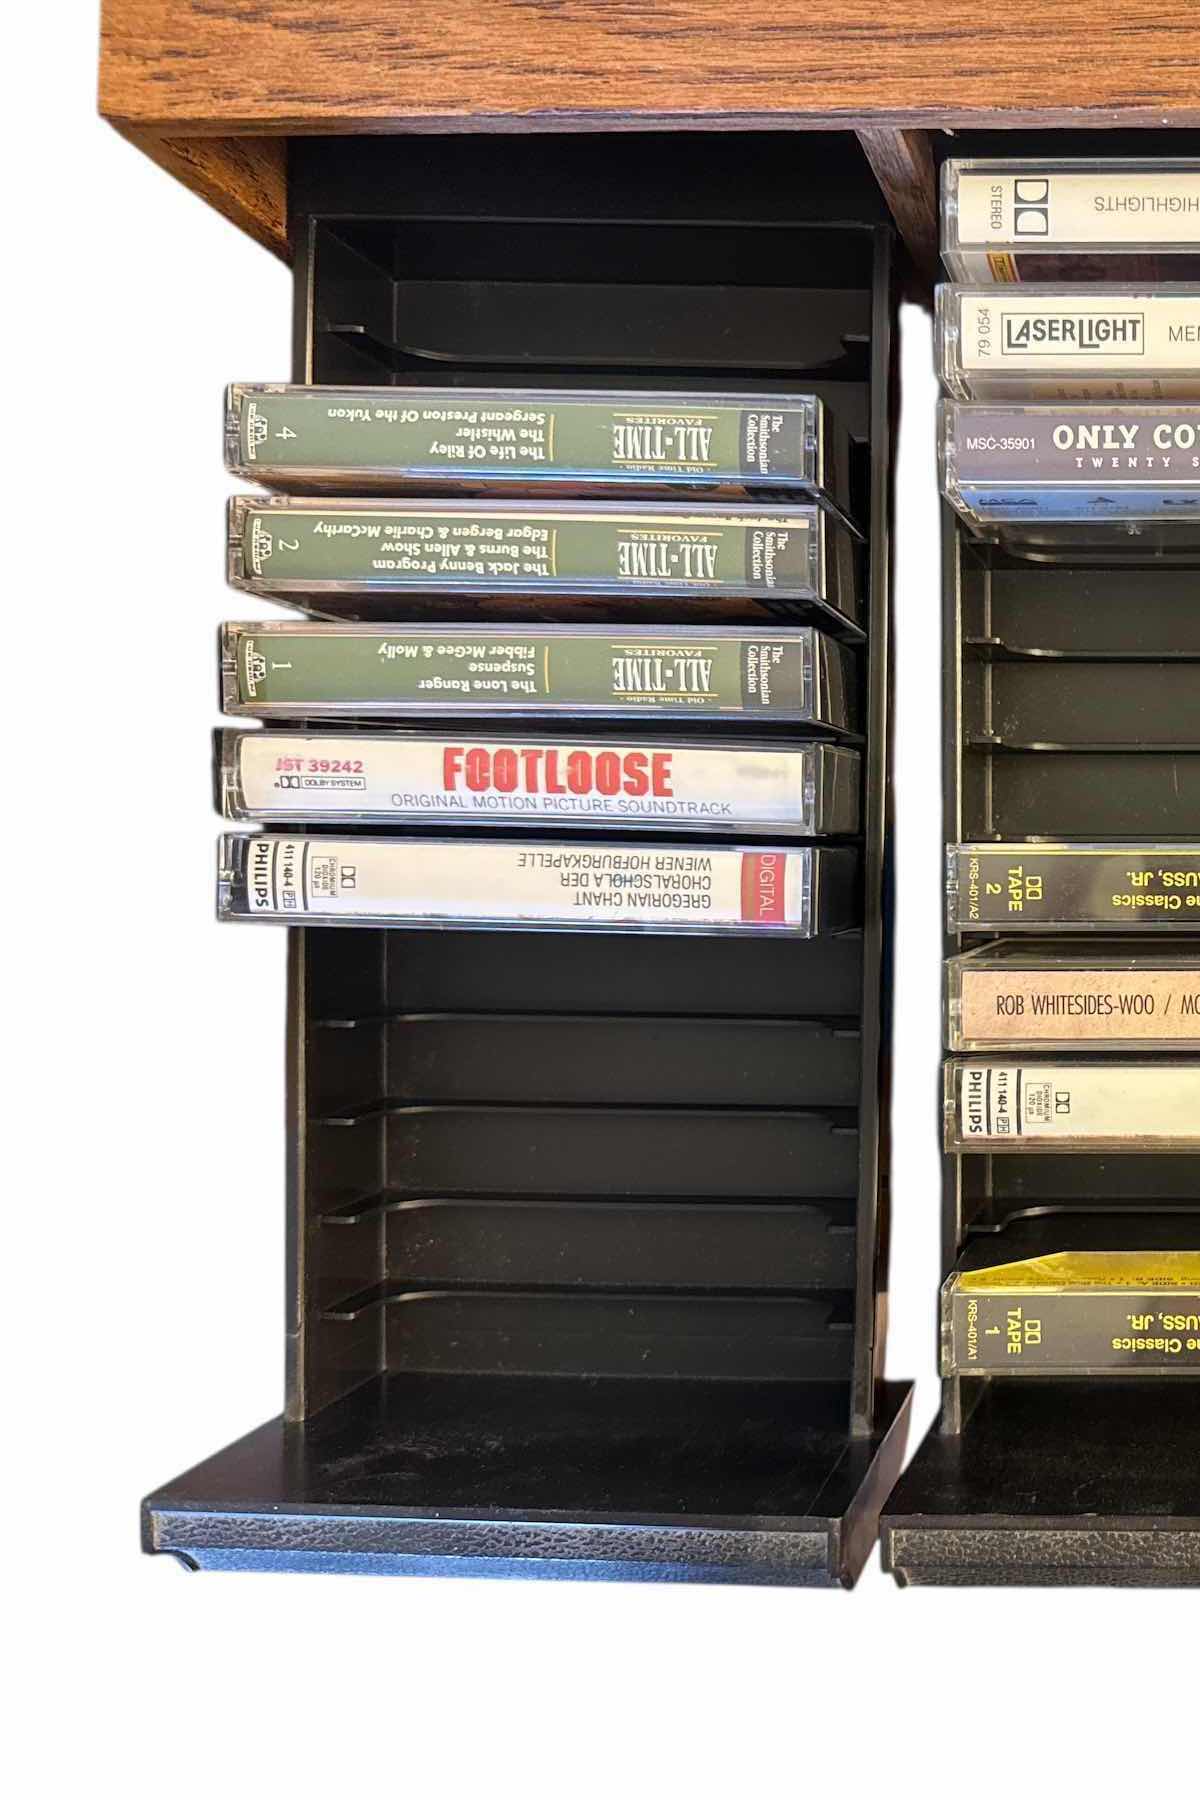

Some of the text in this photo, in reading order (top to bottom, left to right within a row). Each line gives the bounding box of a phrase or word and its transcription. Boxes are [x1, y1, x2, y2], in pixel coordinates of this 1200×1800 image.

[990, 185, 1003, 230] STEREO
[1094, 196, 1200, 212] HIGHLIGHTS
[977, 308, 991, 357] 79 054
[327, 408, 546, 425] Sergeant Preston Of the Yukon
[625, 417, 703, 426] FAVORITES
[771, 414, 784, 433] The
[275, 426, 297, 440] 4
[455, 427, 545, 442] The Whistler
[746, 413, 759, 463] Collection
[1052, 424, 1139, 450] ONLY
[429, 441, 544, 460] The Life Of Riley
[758, 414, 770, 475] Smithsonian
[966, 437, 1035, 450] MSC-35901
[625, 464, 656, 472] Radio
[658, 465, 682, 473] Time
[1075, 456, 1171, 468] TWENTY
[313, 520, 548, 542] Edgar Bergen & Charlie McCarthy
[631, 533, 708, 543] FAVORITES
[278, 538, 300, 551] 2
[776, 531, 789, 550] The
[381, 541, 548, 559] The Burns & Allen Show
[752, 531, 764, 580] Collection
[372, 558, 549, 576] The Jack Benny Program
[378, 642, 536, 659] Fibber McGee & Molly
[624, 648, 703, 657] FAVORITES
[771, 646, 784, 664] The
[272, 660, 293, 671] 1
[469, 662, 536, 676] Suspense
[747, 645, 759, 694] Collection
[758, 645, 770, 705] Smithsonian
[417, 678, 537, 693] The Lone Ranger
[626, 695, 656, 703] Radio
[658, 696, 682, 704] Time
[308, 759, 365, 773] 39242
[443, 746, 673, 798] FOOTLOOSE
[303, 779, 363, 788] DOLBY SYSTEM
[391, 793, 733, 815] ORIGINAL MOTION PICTURE SOUNDTRACK
[282, 843, 296, 887] 411 140-4
[518, 852, 712, 872] WIENER HOFBURGKAPELLE
[254, 843, 270, 908] PHILIPS
[313, 867, 322, 880] 120
[328, 857, 337, 897] CHROMIUM
[560, 872, 711, 891] CHORALSCHOLA DER
[1126, 870, 1154, 887] JR.
[759, 853, 777, 917] DIGITAL
[968, 857, 980, 920] KRS-401/A2
[985, 882, 1001, 895] 2
[1008, 865, 1023, 912] TAPE
[573, 891, 711, 909] GREGORIAN CHANT
[1112, 893, 1182, 908] Classics
[996, 994, 1025, 1015] ROB
[1031, 994, 1155, 1015] WHITESIDES-WOO
[1163, 994, 1172, 1015] /
[997, 1071, 1009, 1114] 411 140-4
[1028, 1093, 1036, 1106] 120
[968, 1071, 983, 1133] PHILIPS
[1042, 1084, 1051, 1121] CHROMIUM
[967, 1299, 978, 1360] KRS-401/A1
[985, 1326, 1001, 1335] 1
[1007, 1307, 1022, 1354] TAPE
[1126, 1314, 1154, 1330] JR.
[1112, 1337, 1182, 1352] Classics
